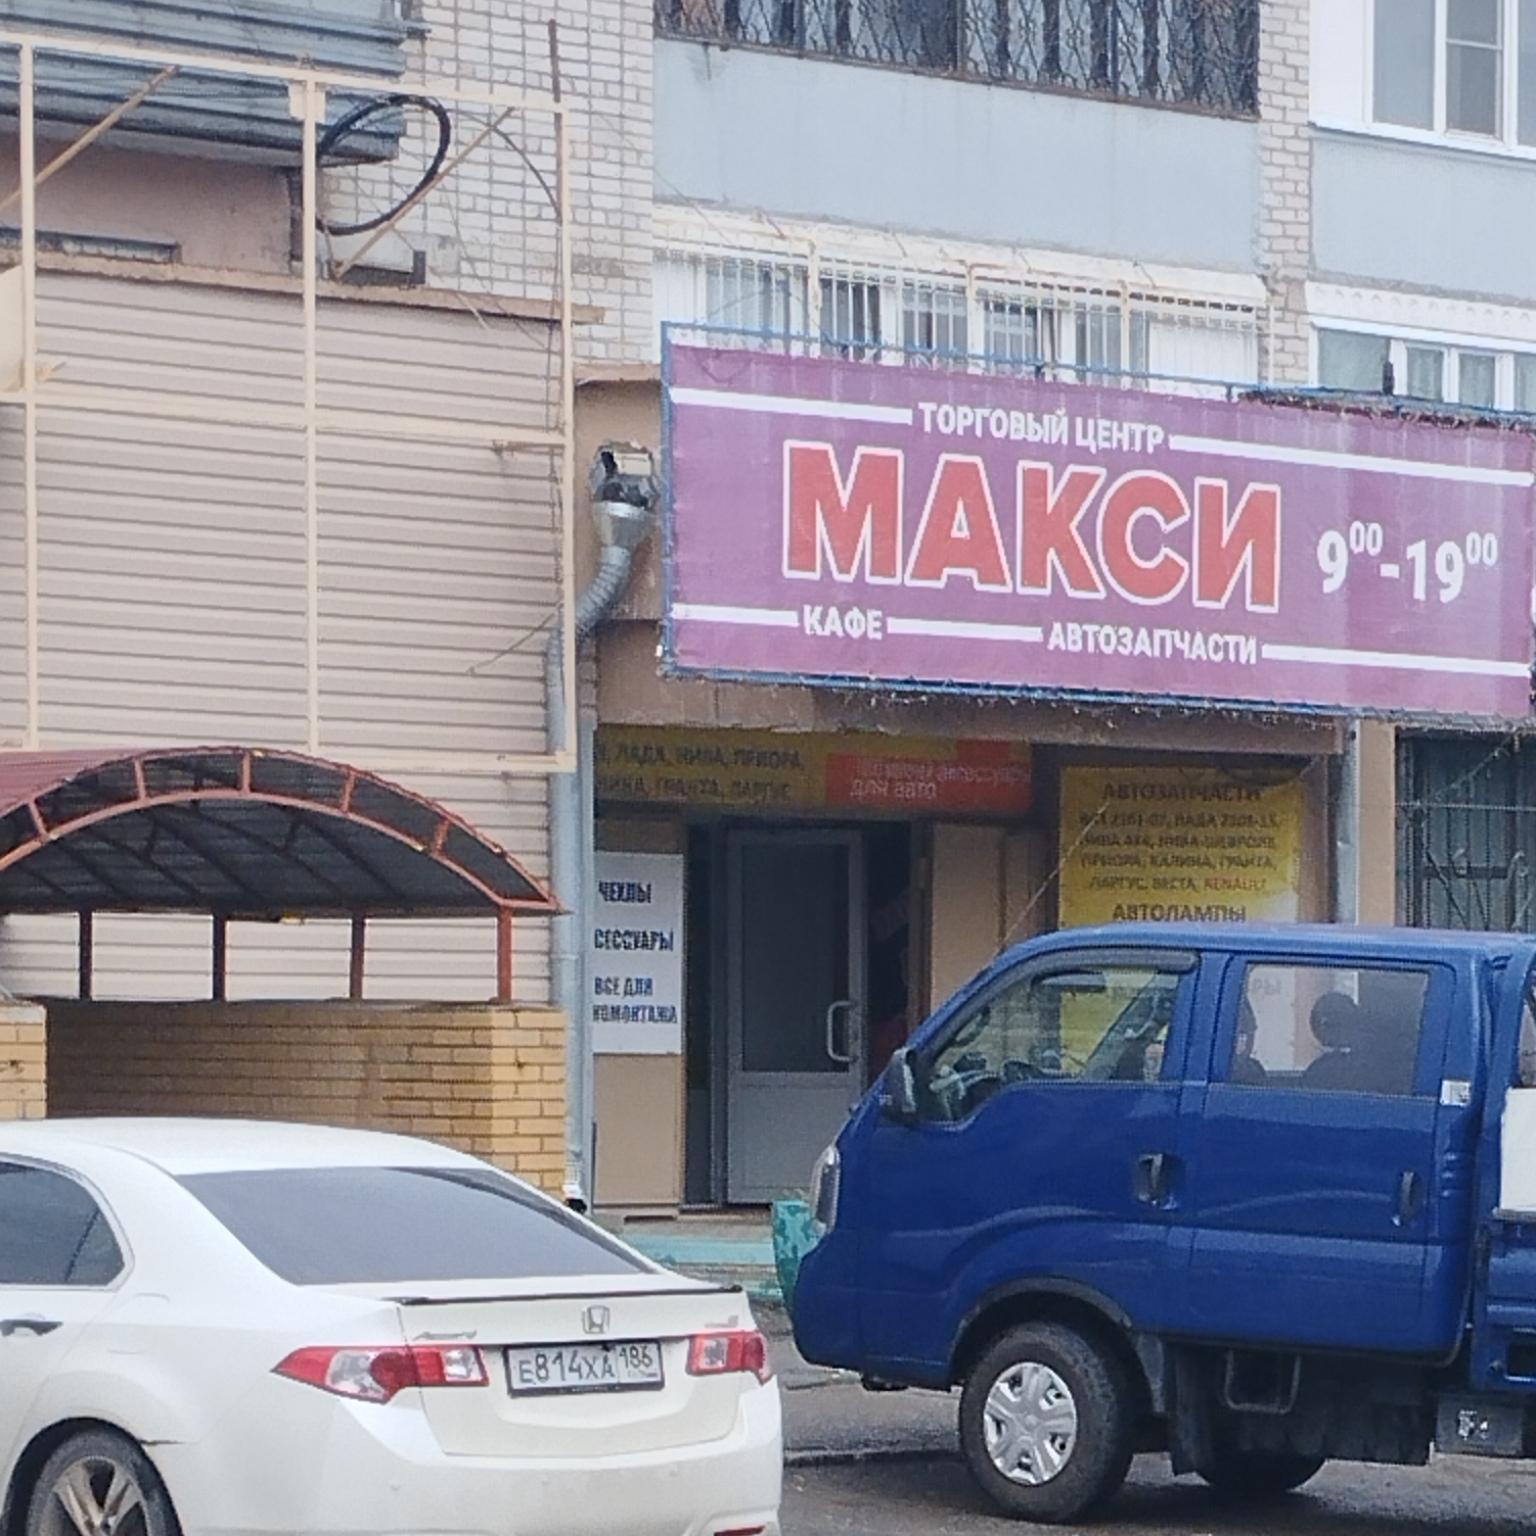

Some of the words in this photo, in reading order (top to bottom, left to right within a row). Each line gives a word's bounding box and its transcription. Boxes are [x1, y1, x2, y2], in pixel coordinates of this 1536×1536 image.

[919, 401, 1068, 445] ТОРГОВЫЙ
[1075, 416, 1165, 454] ЦЕНТР
[782, 439, 1282, 614] МАКСИ
[803, 605, 883, 640] КАФЕ
[1047, 622, 1258, 665] АВТОЗАПЧАСТИ
[1112, 903, 1247, 922] АВТОЛАМПЫ
